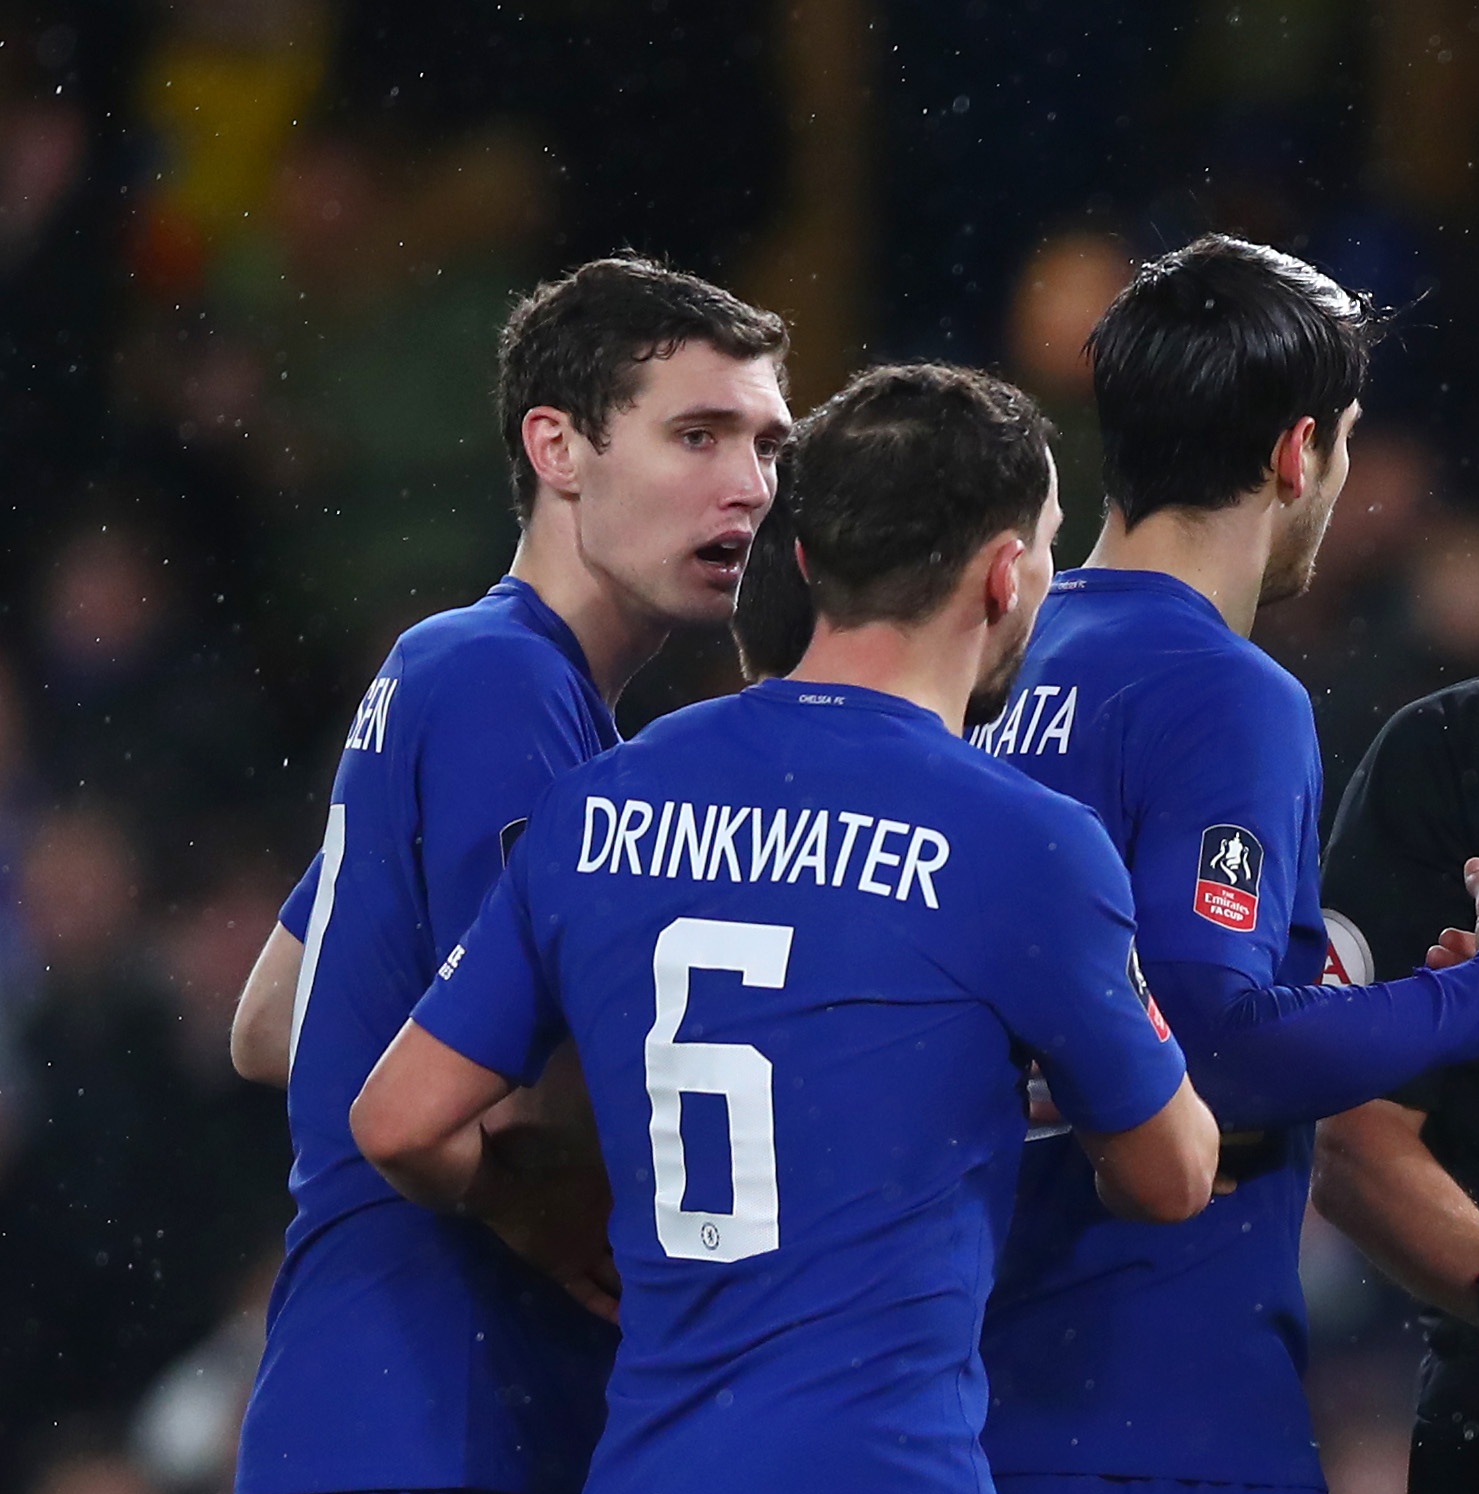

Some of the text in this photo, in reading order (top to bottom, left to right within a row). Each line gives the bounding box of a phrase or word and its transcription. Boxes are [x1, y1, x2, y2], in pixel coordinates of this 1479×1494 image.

[969, 685, 1078, 757] RATA
[576, 796, 950, 909] DRINKWATER
[1204, 893, 1250, 915] Emirates
[1210, 905, 1244, 921] FA CUP
[644, 917, 794, 1263] 6
